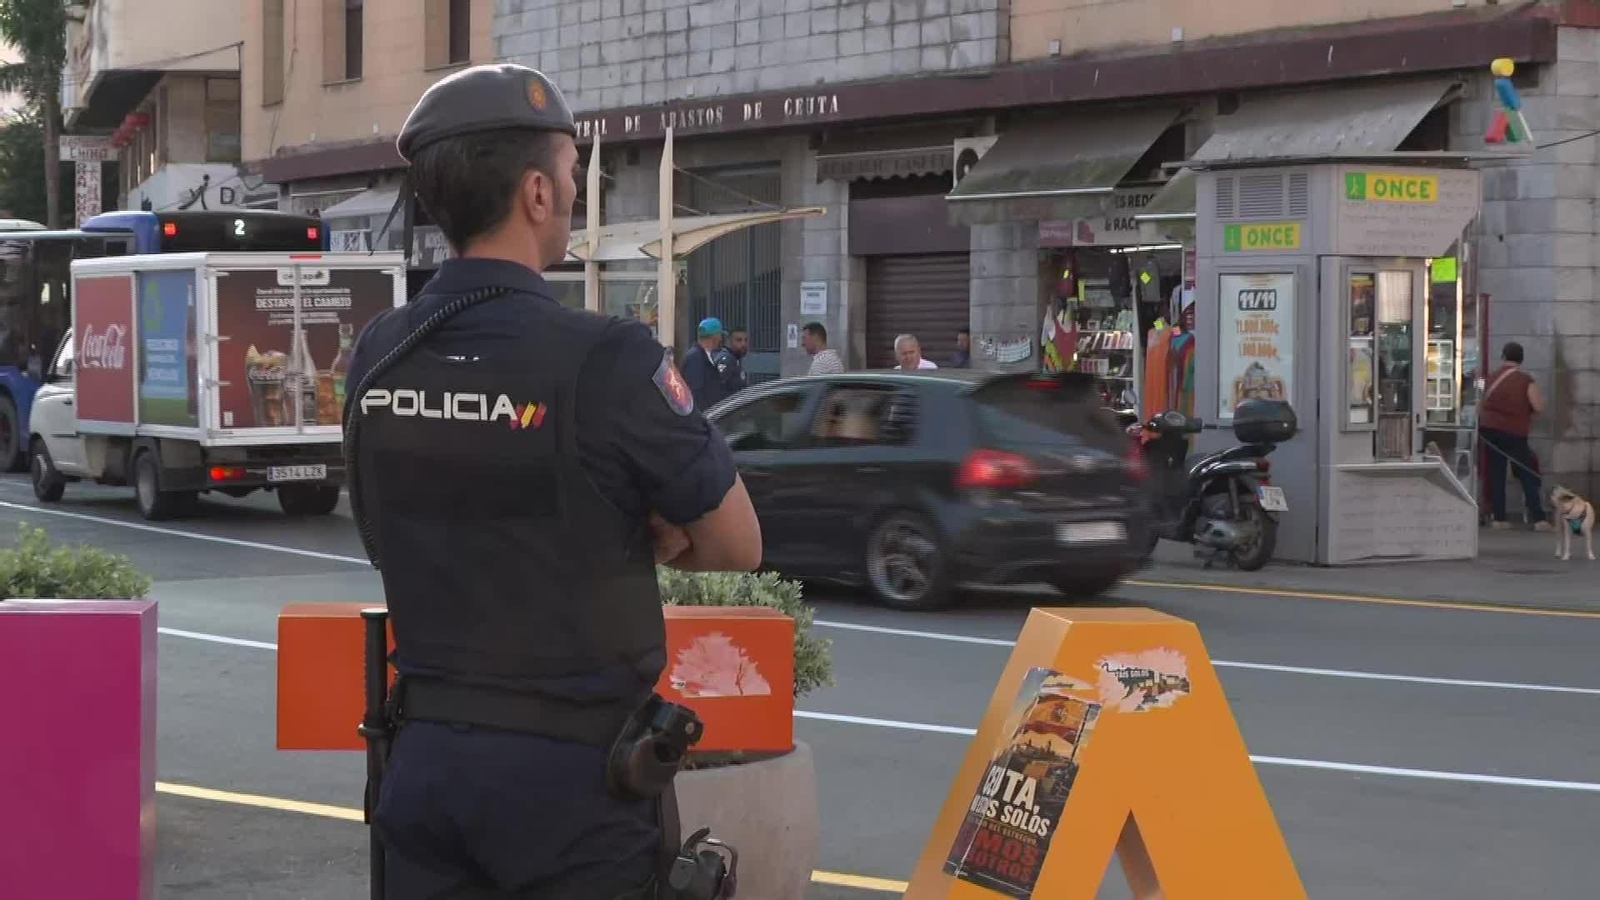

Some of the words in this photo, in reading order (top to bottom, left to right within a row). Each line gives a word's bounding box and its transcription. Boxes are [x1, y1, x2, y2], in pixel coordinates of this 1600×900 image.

[574, 118, 607, 138] TRAL
[624, 114, 641, 134] DE
[659, 105, 723, 130] ABASTOS
[744, 101, 762, 121] DE
[784, 95, 839, 117] CEUTA
[1374, 179, 1431, 199] ONCE
[234, 218, 246, 236] 2
[1247, 227, 1294, 246] ONCE
[1240, 291, 1275, 309] 11/11
[360, 388, 518, 421] POLICIA
[1001, 805, 1050, 837] SOLOS
